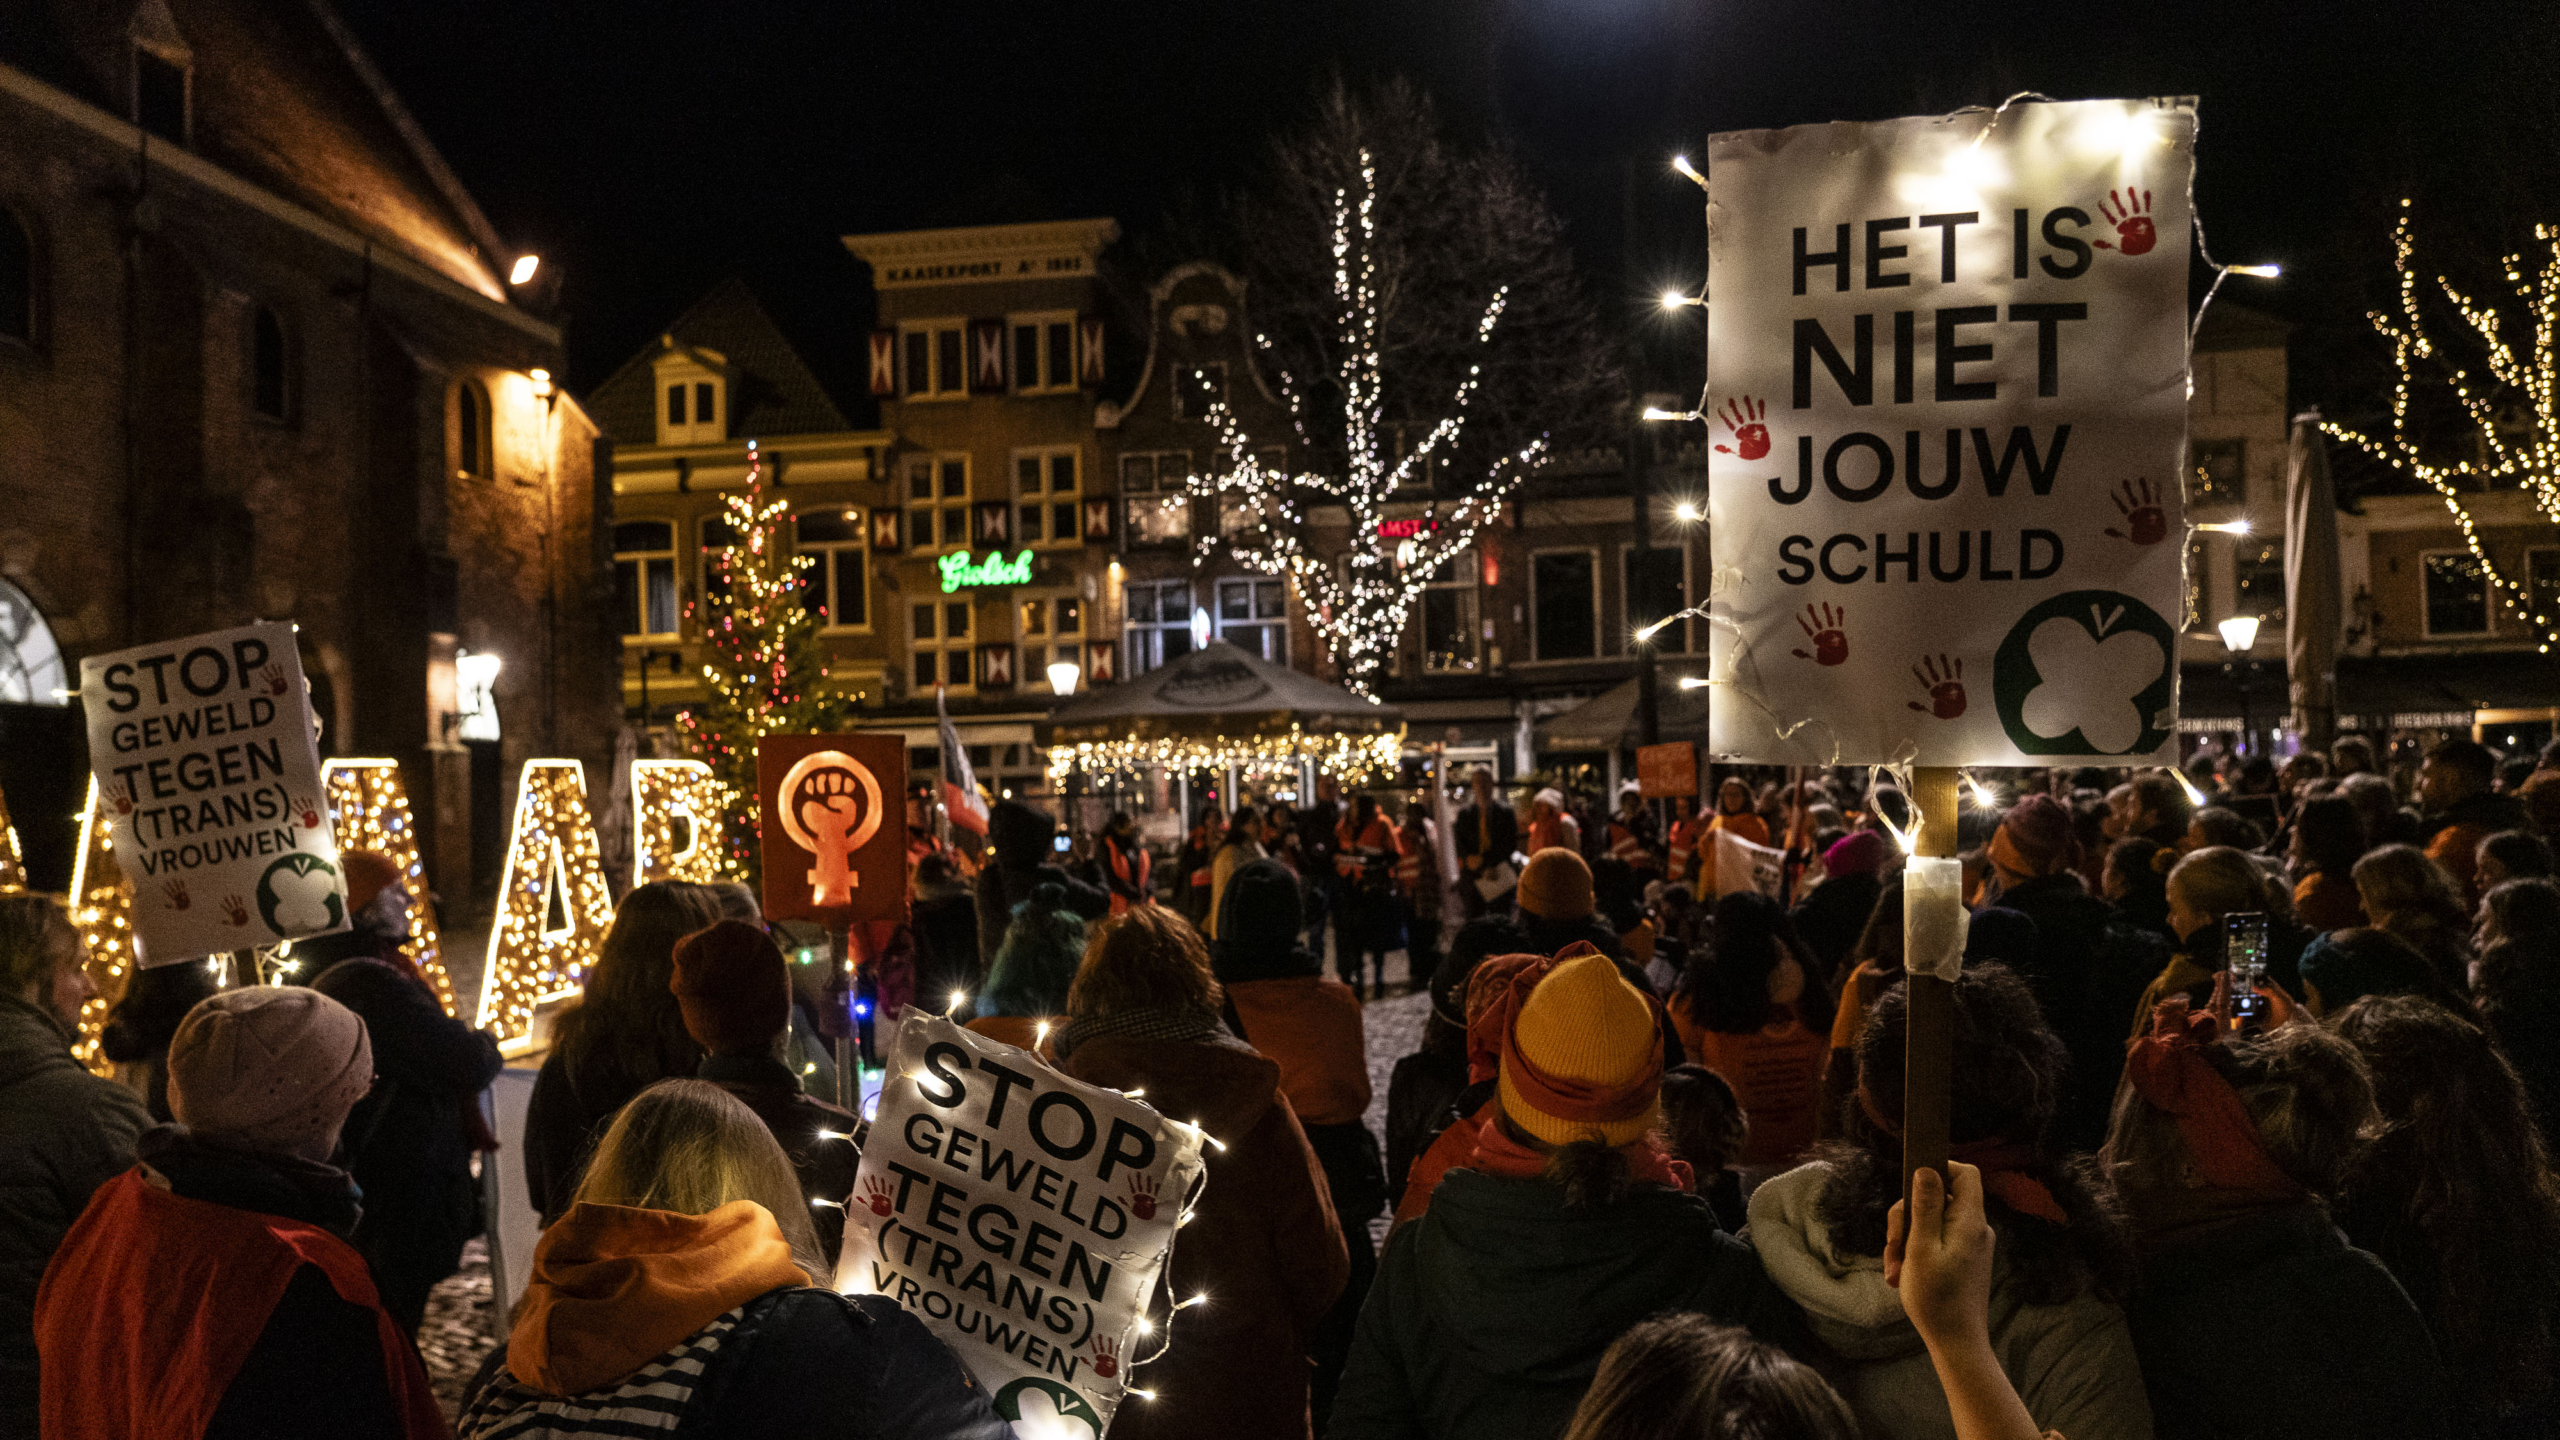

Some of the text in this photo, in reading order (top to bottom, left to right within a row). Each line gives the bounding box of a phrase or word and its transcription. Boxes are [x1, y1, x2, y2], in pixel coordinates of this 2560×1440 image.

[1792, 205, 2093, 296] HET IS
[1792, 302, 2088, 410] NIET
[1767, 424, 2072, 506] JOUW
[938, 549, 1034, 593] Grolsch
[1776, 528, 2065, 586] SCHULD
[104, 638, 269, 713] STOP
[111, 697, 276, 752] GEWELD
[113, 738, 285, 803] TEGEN
[132, 782, 290, 848] (TRANS)
[139, 827, 297, 876] VROUWEN
[916, 1041, 1156, 1182] STOP
[903, 1113, 1128, 1240] GEWELD
[887, 1160, 1112, 1303] TEGEN
[872, 1261, 1080, 1383] VROUWEN
[877, 1217, 1094, 1349] (TRANS)
